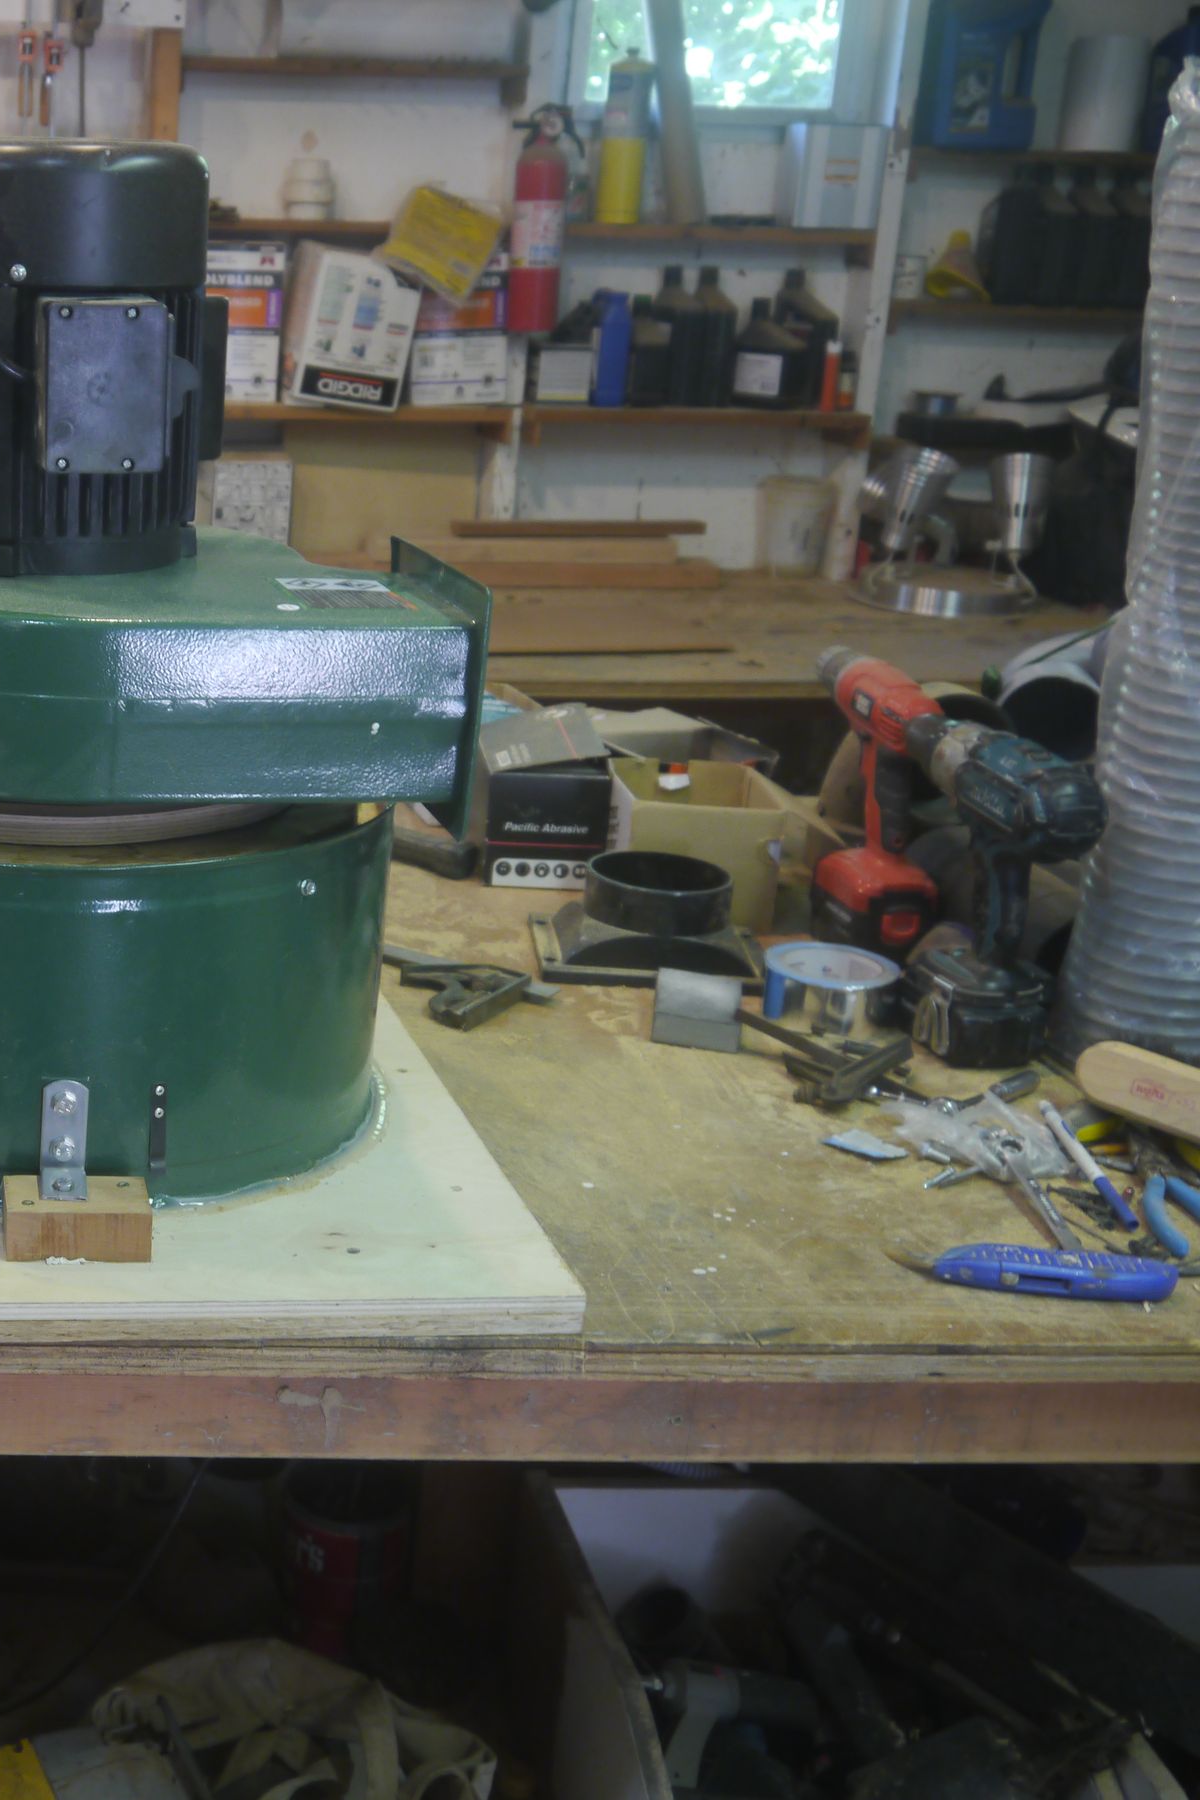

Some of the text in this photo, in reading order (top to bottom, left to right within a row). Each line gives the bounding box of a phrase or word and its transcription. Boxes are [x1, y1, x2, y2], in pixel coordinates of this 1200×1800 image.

[317, 376, 383, 401] RIDGID
[504, 821, 589, 835] Pacific Abrasive
